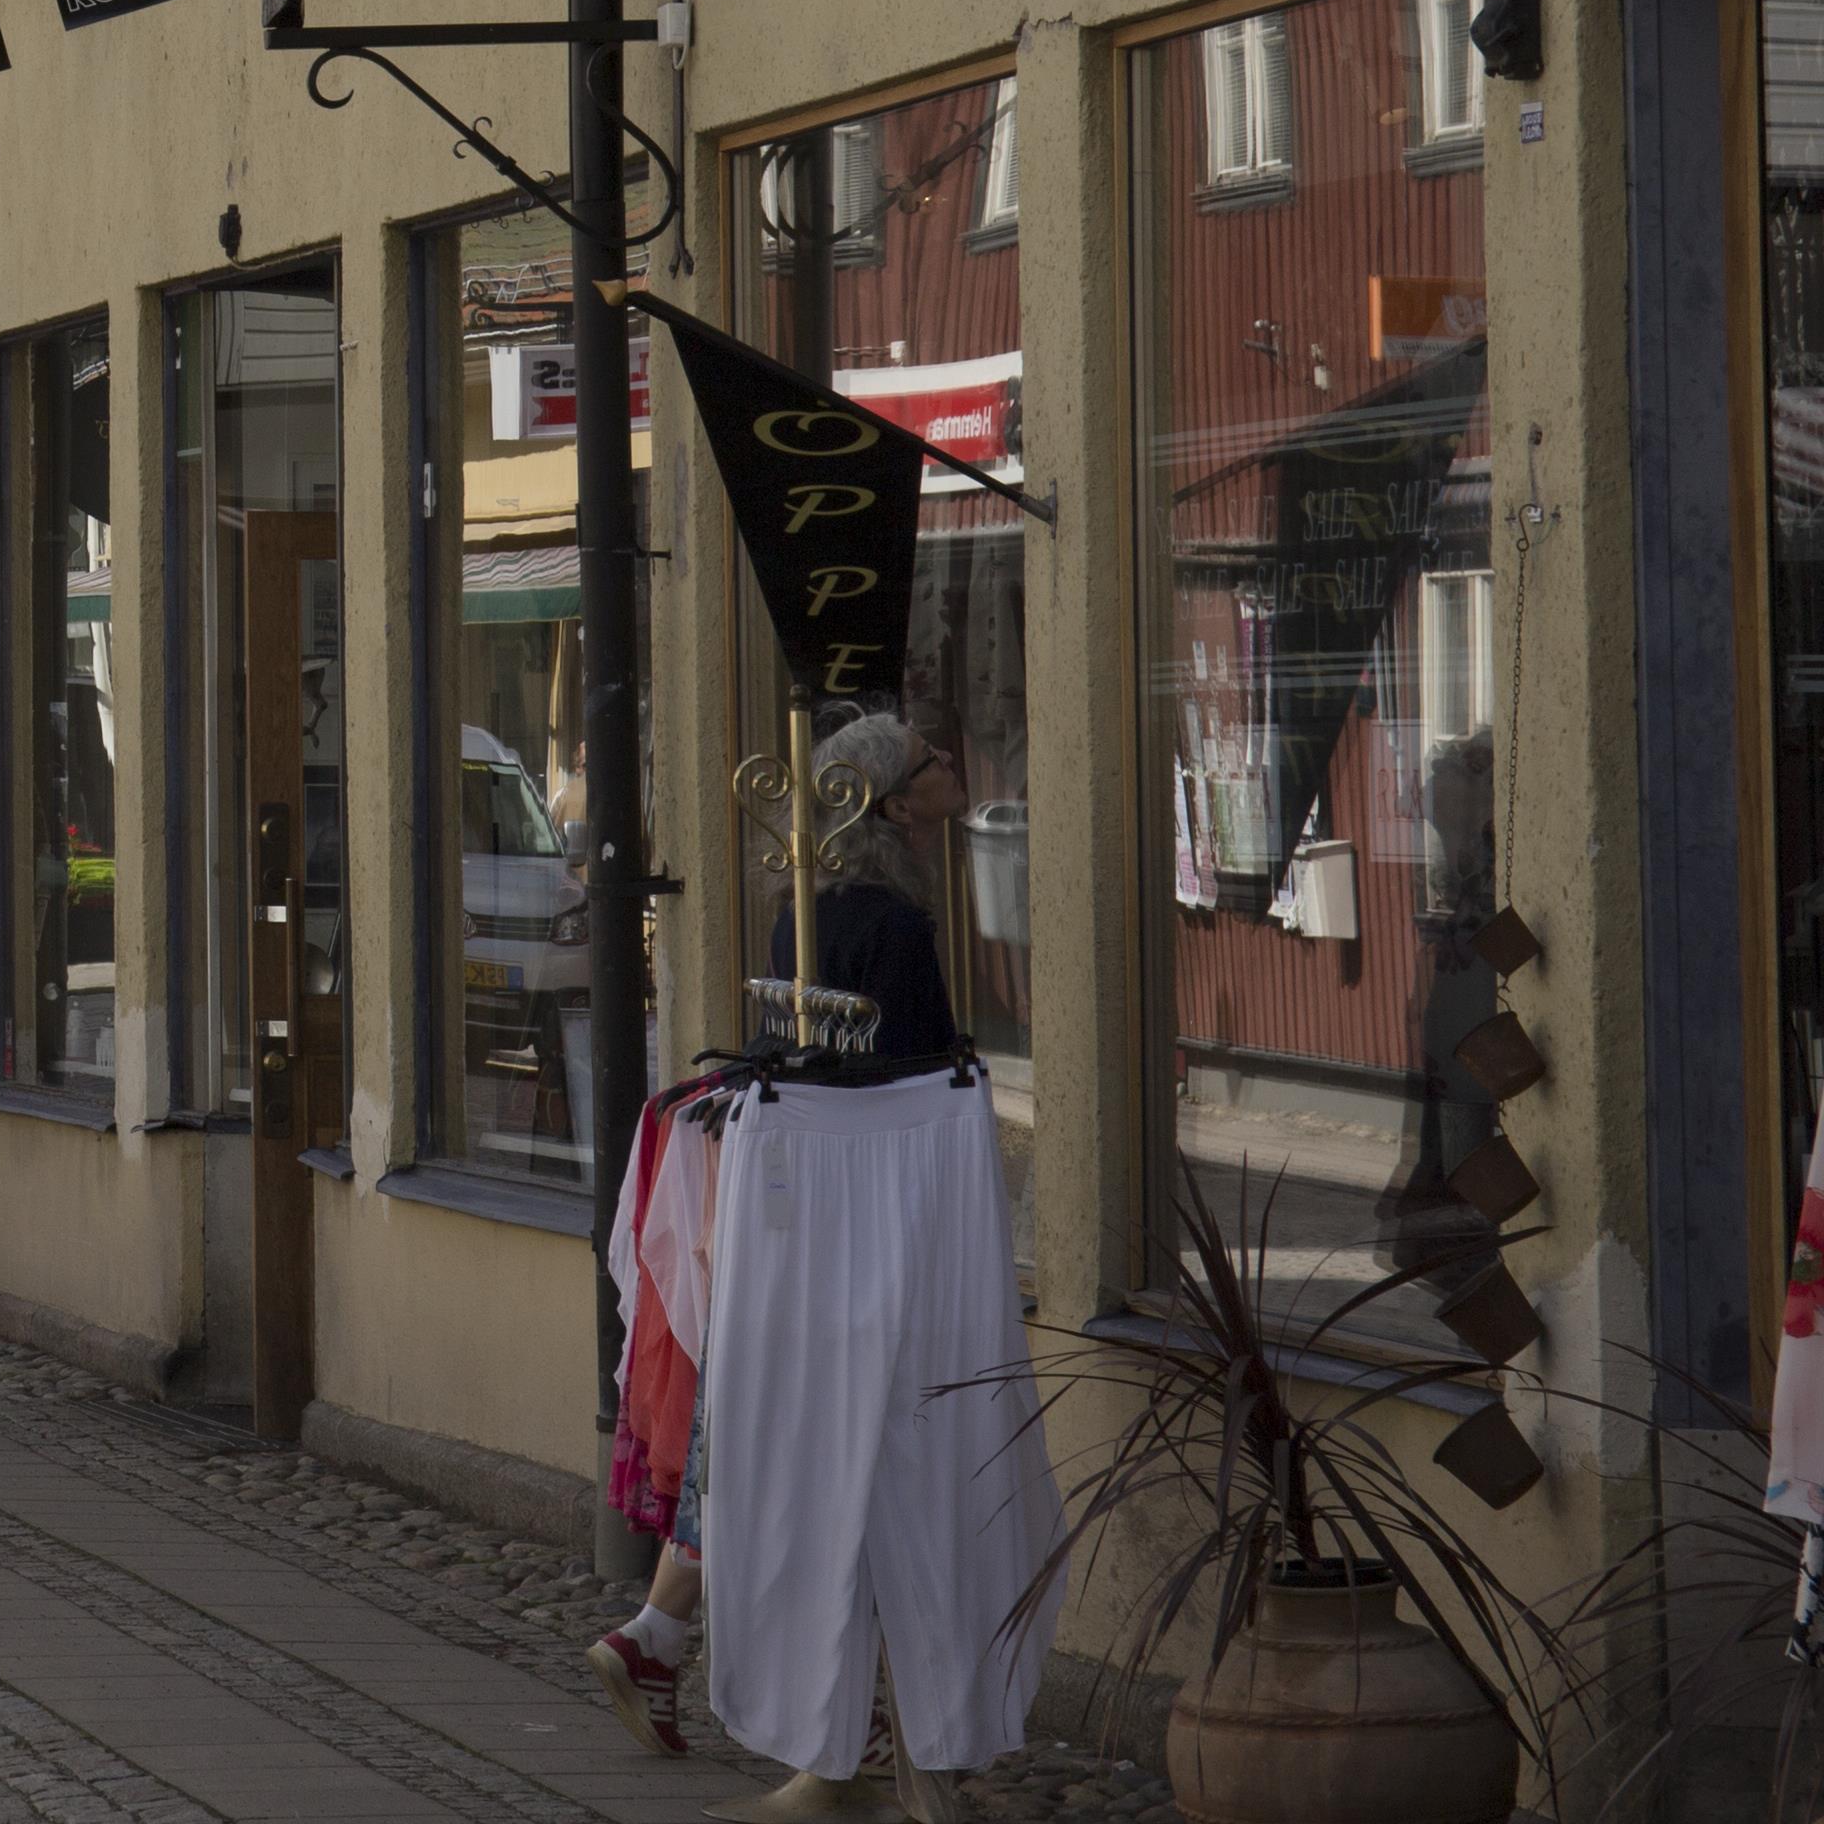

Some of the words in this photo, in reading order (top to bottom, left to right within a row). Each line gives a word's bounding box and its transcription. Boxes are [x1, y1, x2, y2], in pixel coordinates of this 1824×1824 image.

[1303, 487, 1355, 543] SALE
[1385, 479, 1440, 537] SALE
[1333, 556, 1387, 611] SALE
